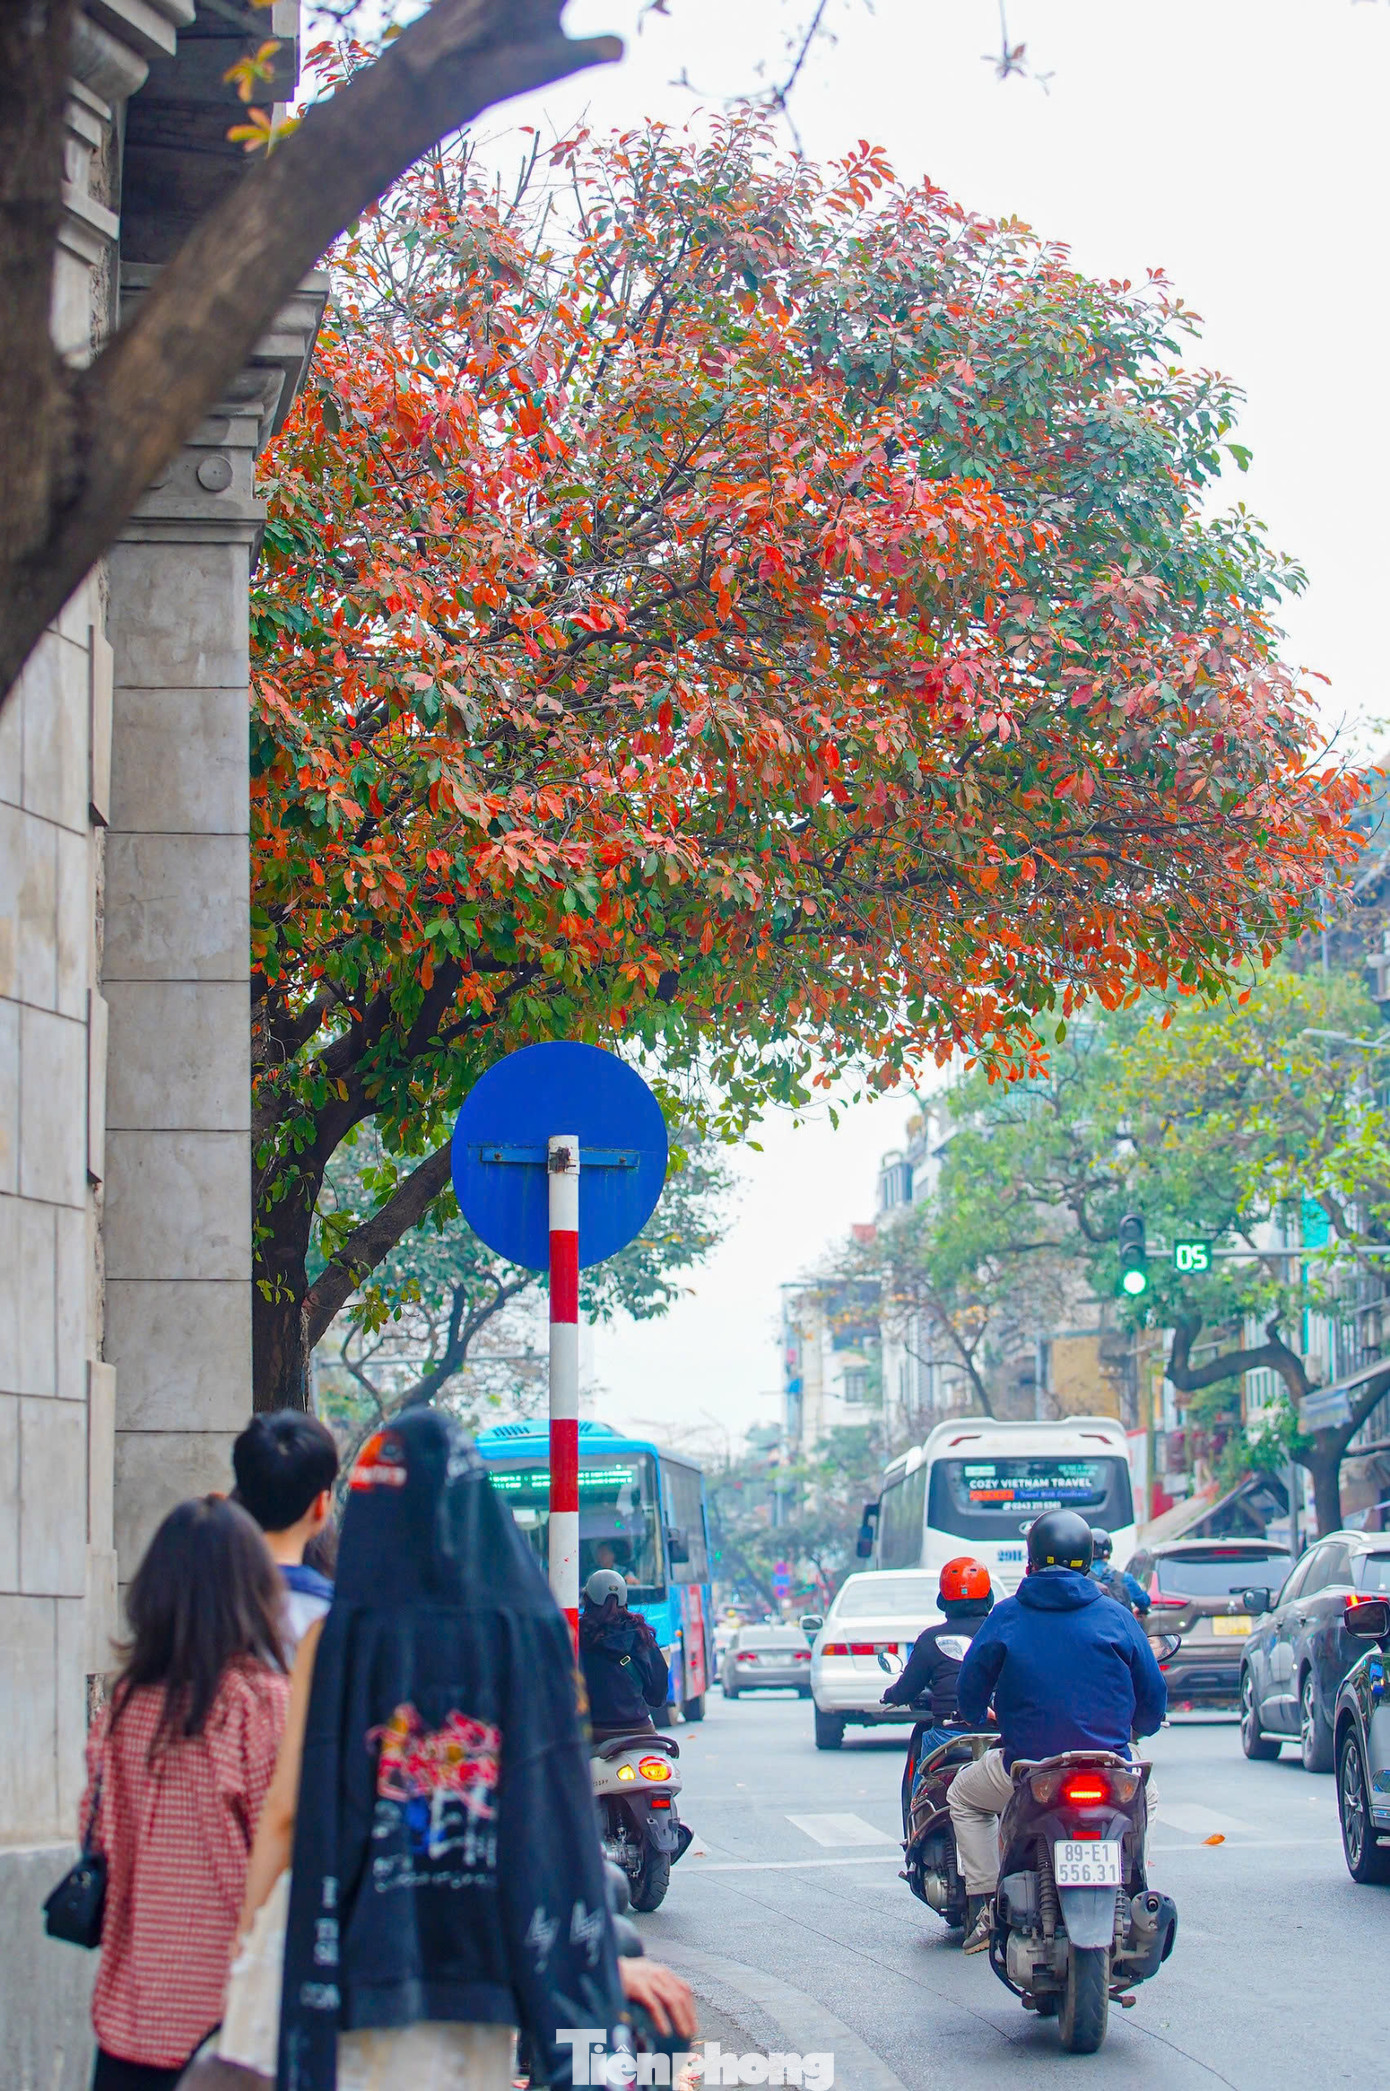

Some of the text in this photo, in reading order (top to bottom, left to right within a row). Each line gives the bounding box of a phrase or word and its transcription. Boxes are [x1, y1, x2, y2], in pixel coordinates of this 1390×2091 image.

[1176, 1244, 1208, 1270] 05
[969, 1477, 1092, 1490] COZY VIETNAM TRAVEL
[1065, 1843, 1110, 1862] 89-E1
[1059, 1864, 1116, 1882] 556.31
